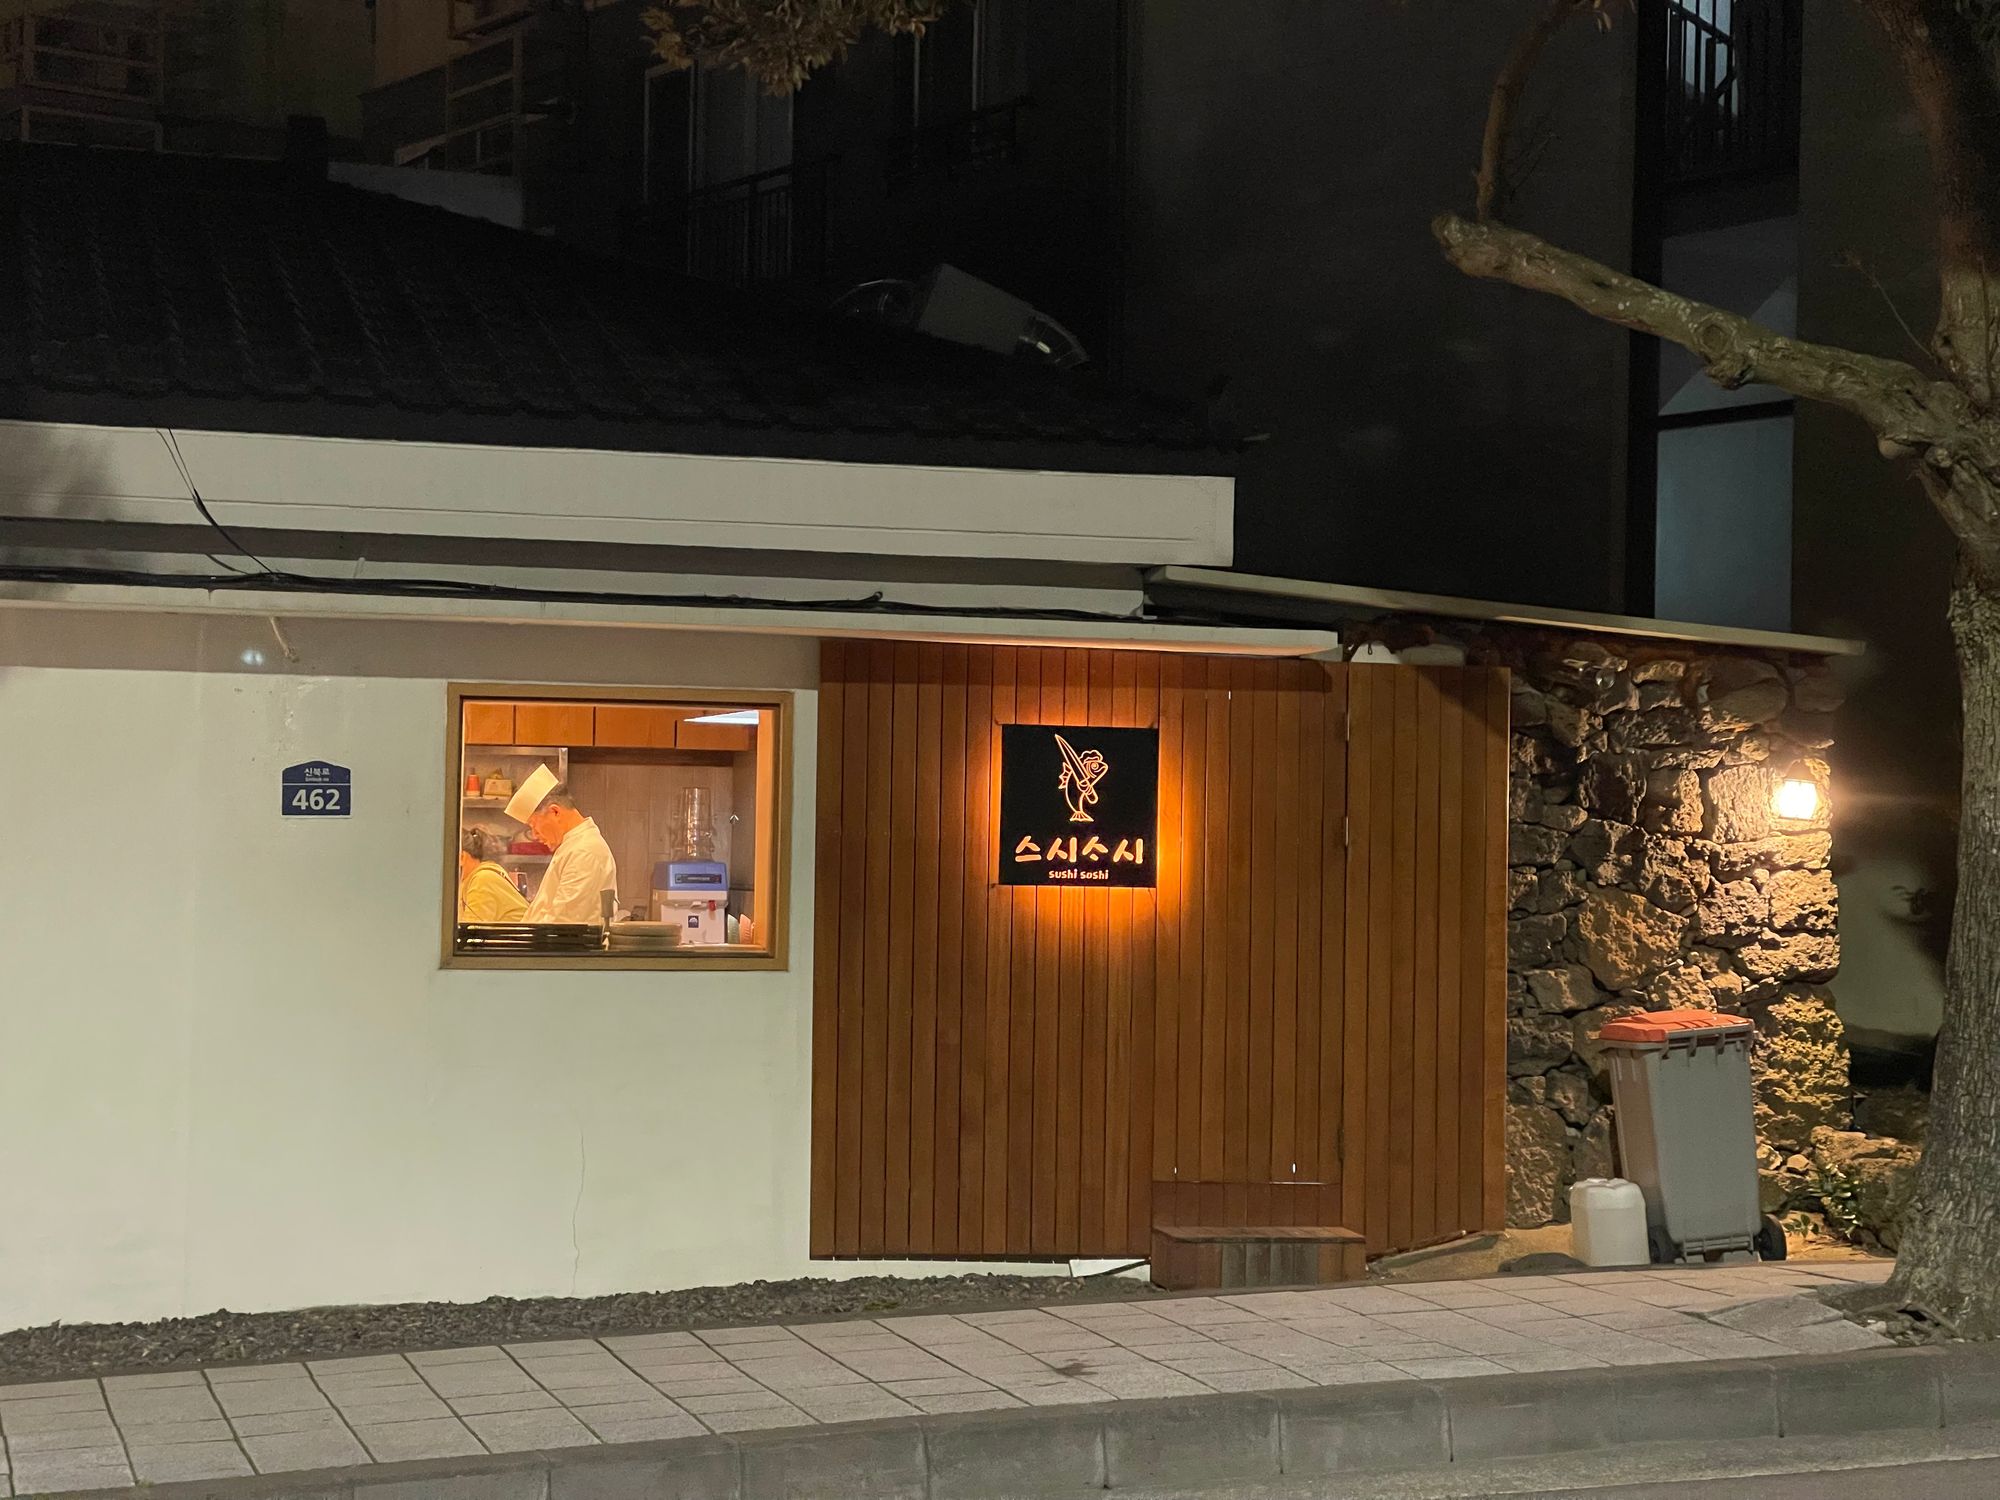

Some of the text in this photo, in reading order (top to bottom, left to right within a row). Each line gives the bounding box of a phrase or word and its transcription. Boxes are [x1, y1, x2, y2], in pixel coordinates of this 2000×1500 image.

[292, 788, 341, 810] 462
[1048, 868, 1109, 880] sushi soshi
